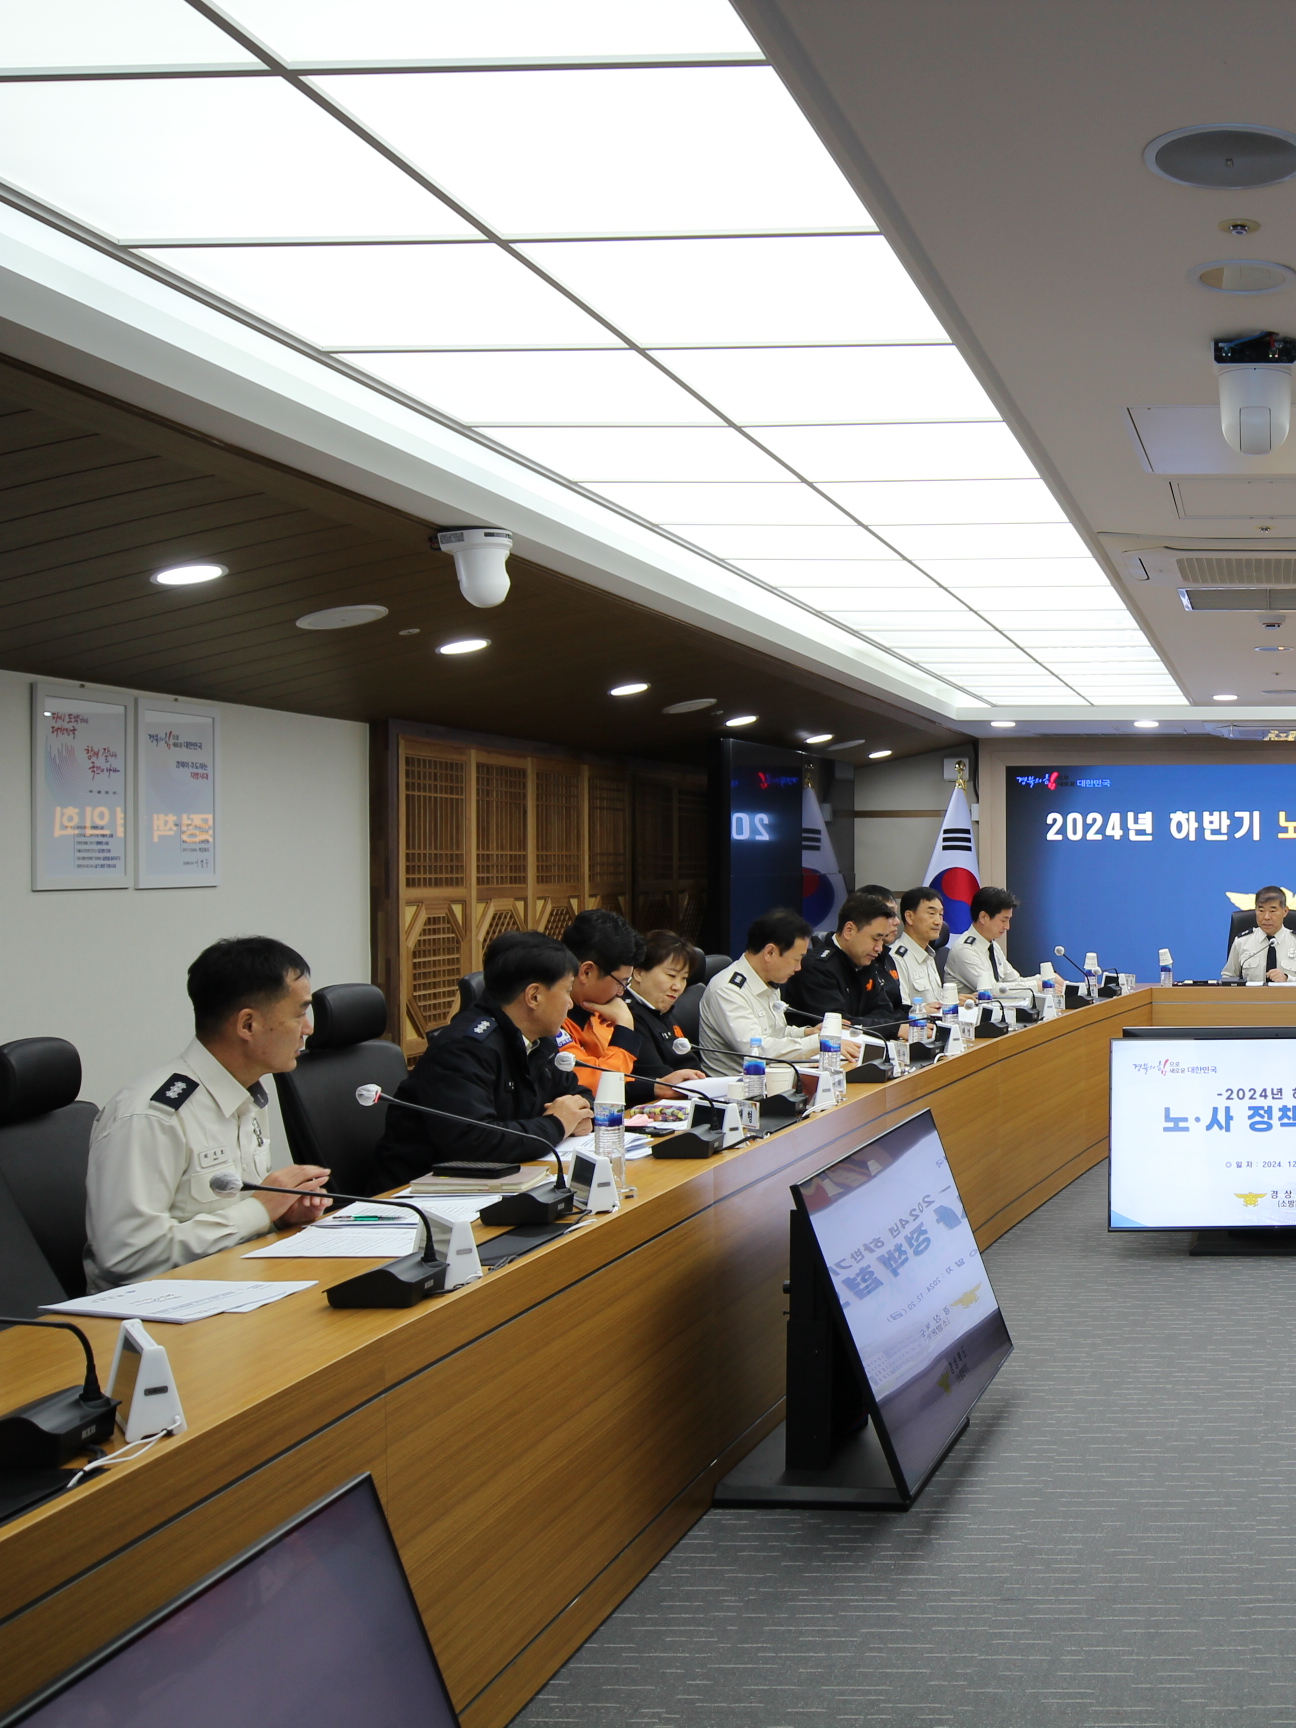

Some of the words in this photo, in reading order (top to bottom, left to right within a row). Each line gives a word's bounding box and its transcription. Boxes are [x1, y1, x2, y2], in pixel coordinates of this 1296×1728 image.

[1077, 779, 1111, 788] 대한민국
[1046, 811, 1153, 842] 2024년
[1169, 810, 1260, 842] 하반기
[1187, 1066, 1217, 1074] 대한민국
[1162, 1105, 1234, 1133] 노·사
